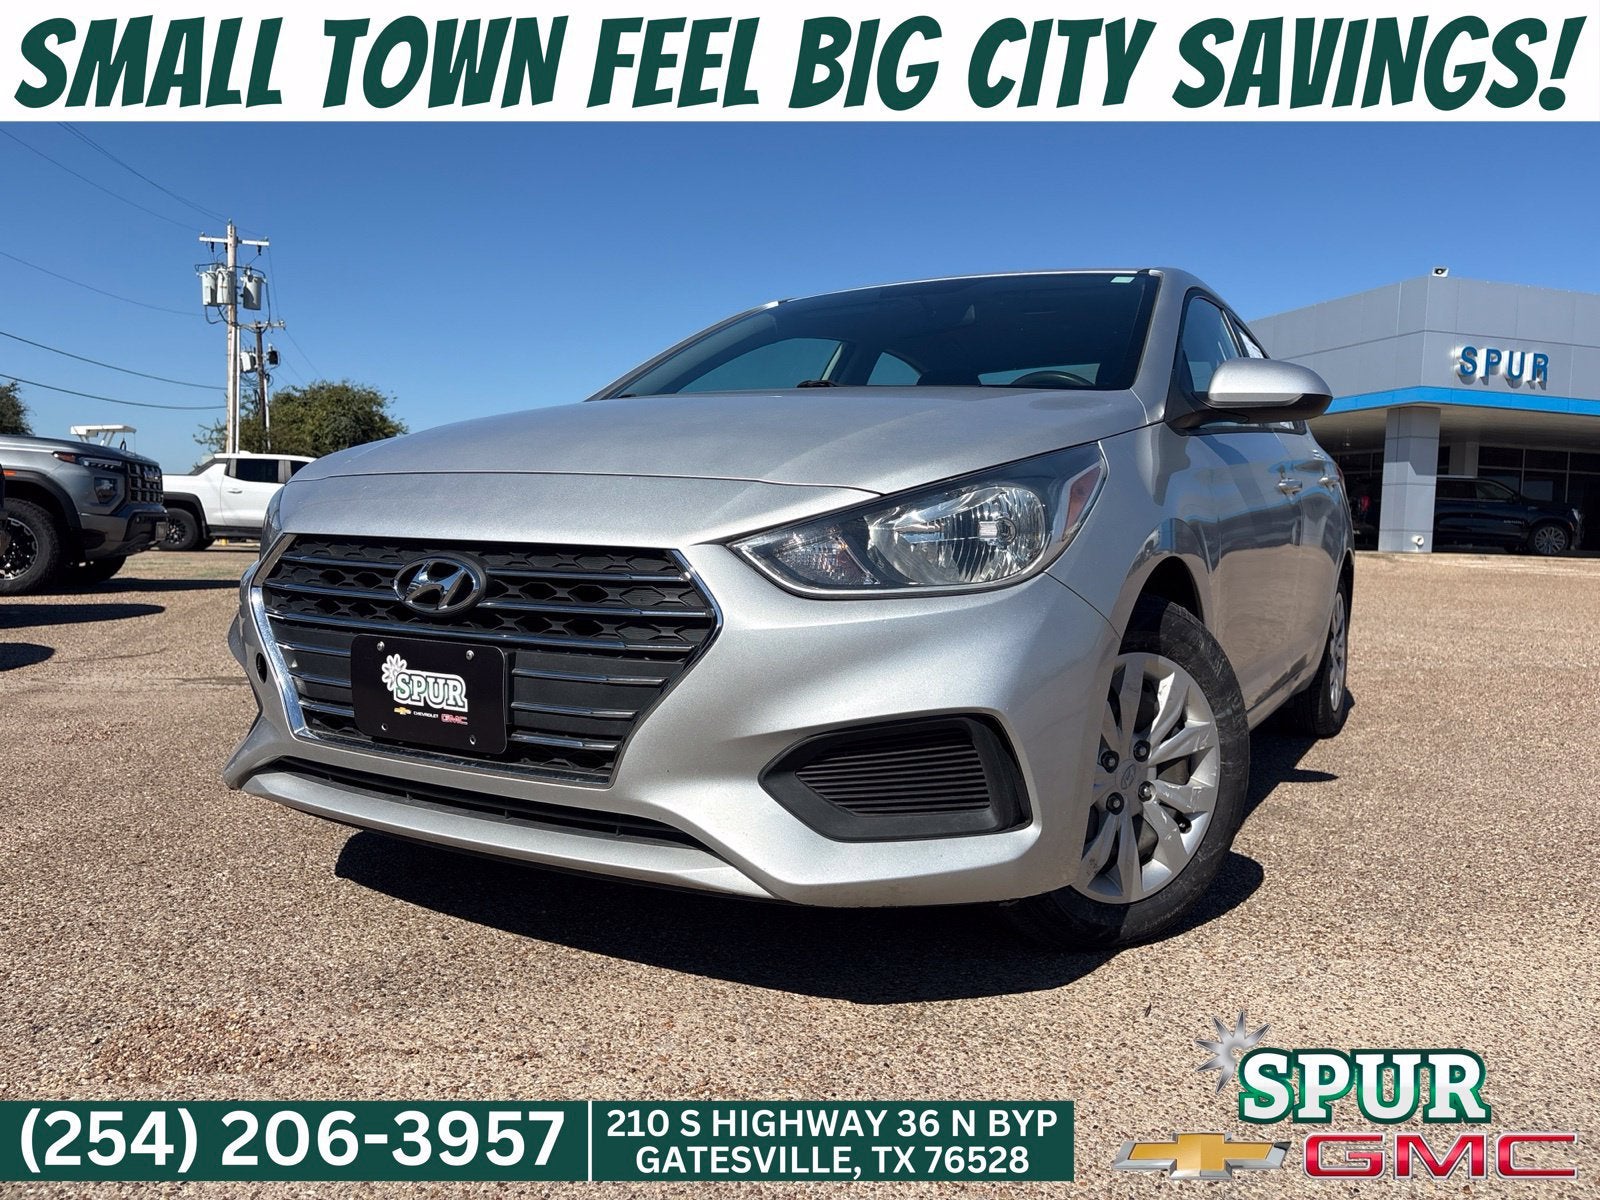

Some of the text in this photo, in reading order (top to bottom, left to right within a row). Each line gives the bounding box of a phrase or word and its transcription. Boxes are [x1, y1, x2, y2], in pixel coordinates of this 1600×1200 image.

[1459, 346, 1549, 383] SPUR
[395, 671, 467, 709] SPUR
[441, 713, 468, 725] GMC
